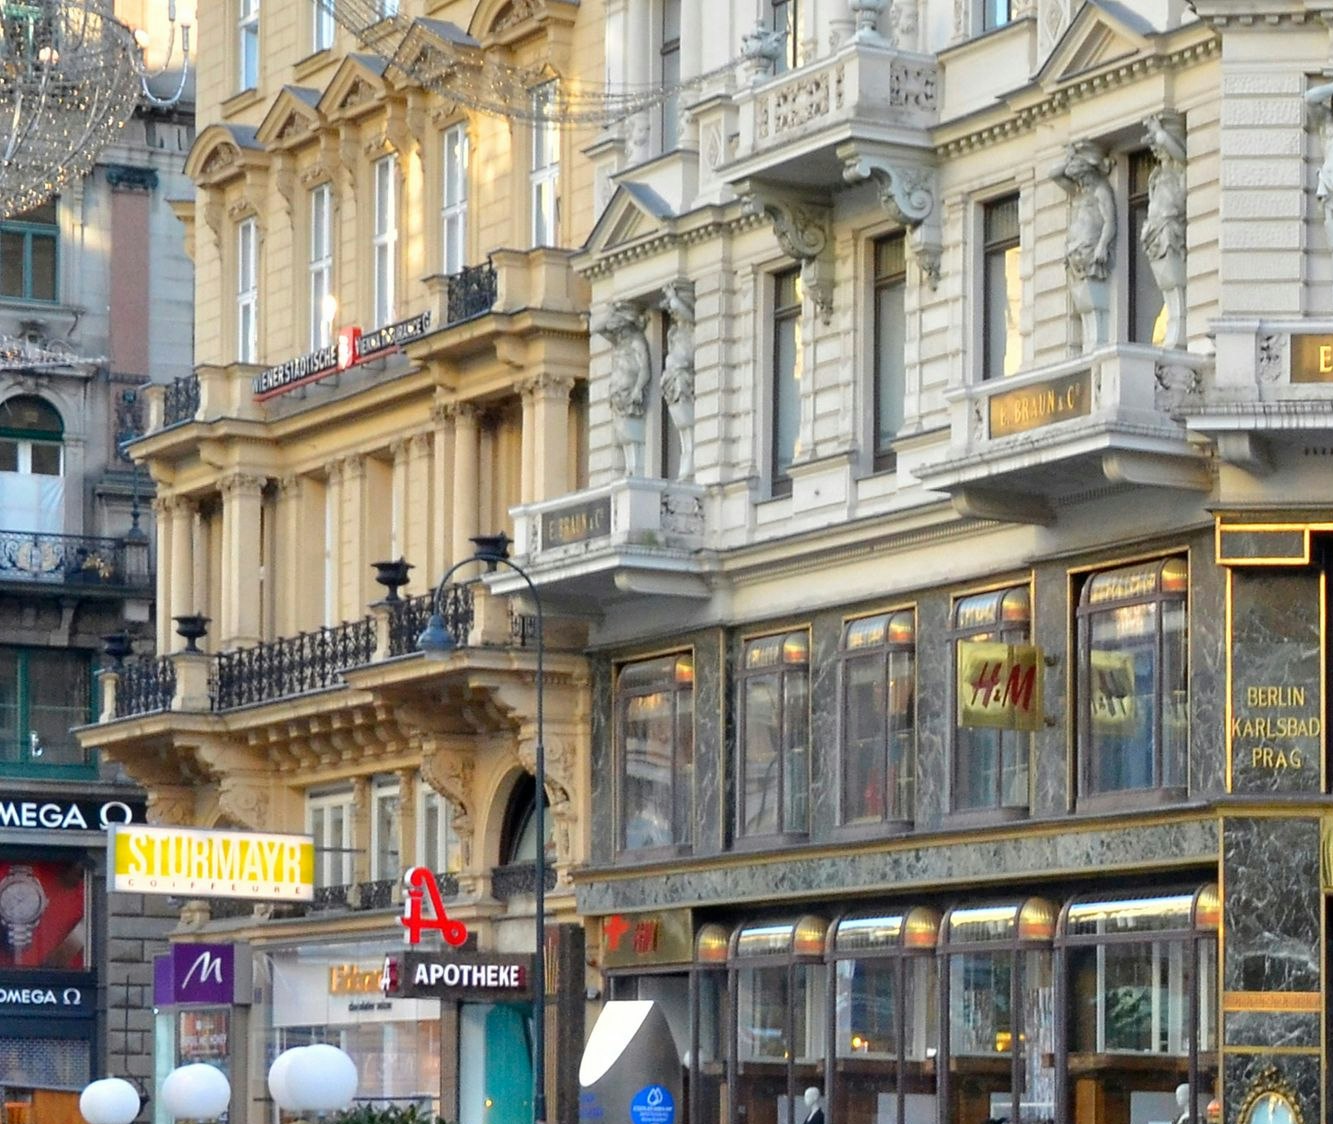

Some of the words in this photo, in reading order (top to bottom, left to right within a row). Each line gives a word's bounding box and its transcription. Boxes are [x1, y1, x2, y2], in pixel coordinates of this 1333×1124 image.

[253, 366, 283, 394] WIENER
[284, 345, 337, 383] STÄDTISCHE
[1014, 390, 1055, 424] BRAUN
[970, 661, 1036, 713] H&M
[1248, 686, 1304, 707] BERLIN
[1232, 716, 1320, 738] KARLSBAD
[1252, 747, 1302, 768] PRAG
[128, 832, 302, 884] STURMAYR
[415, 963, 519, 988] APOTHEKE
